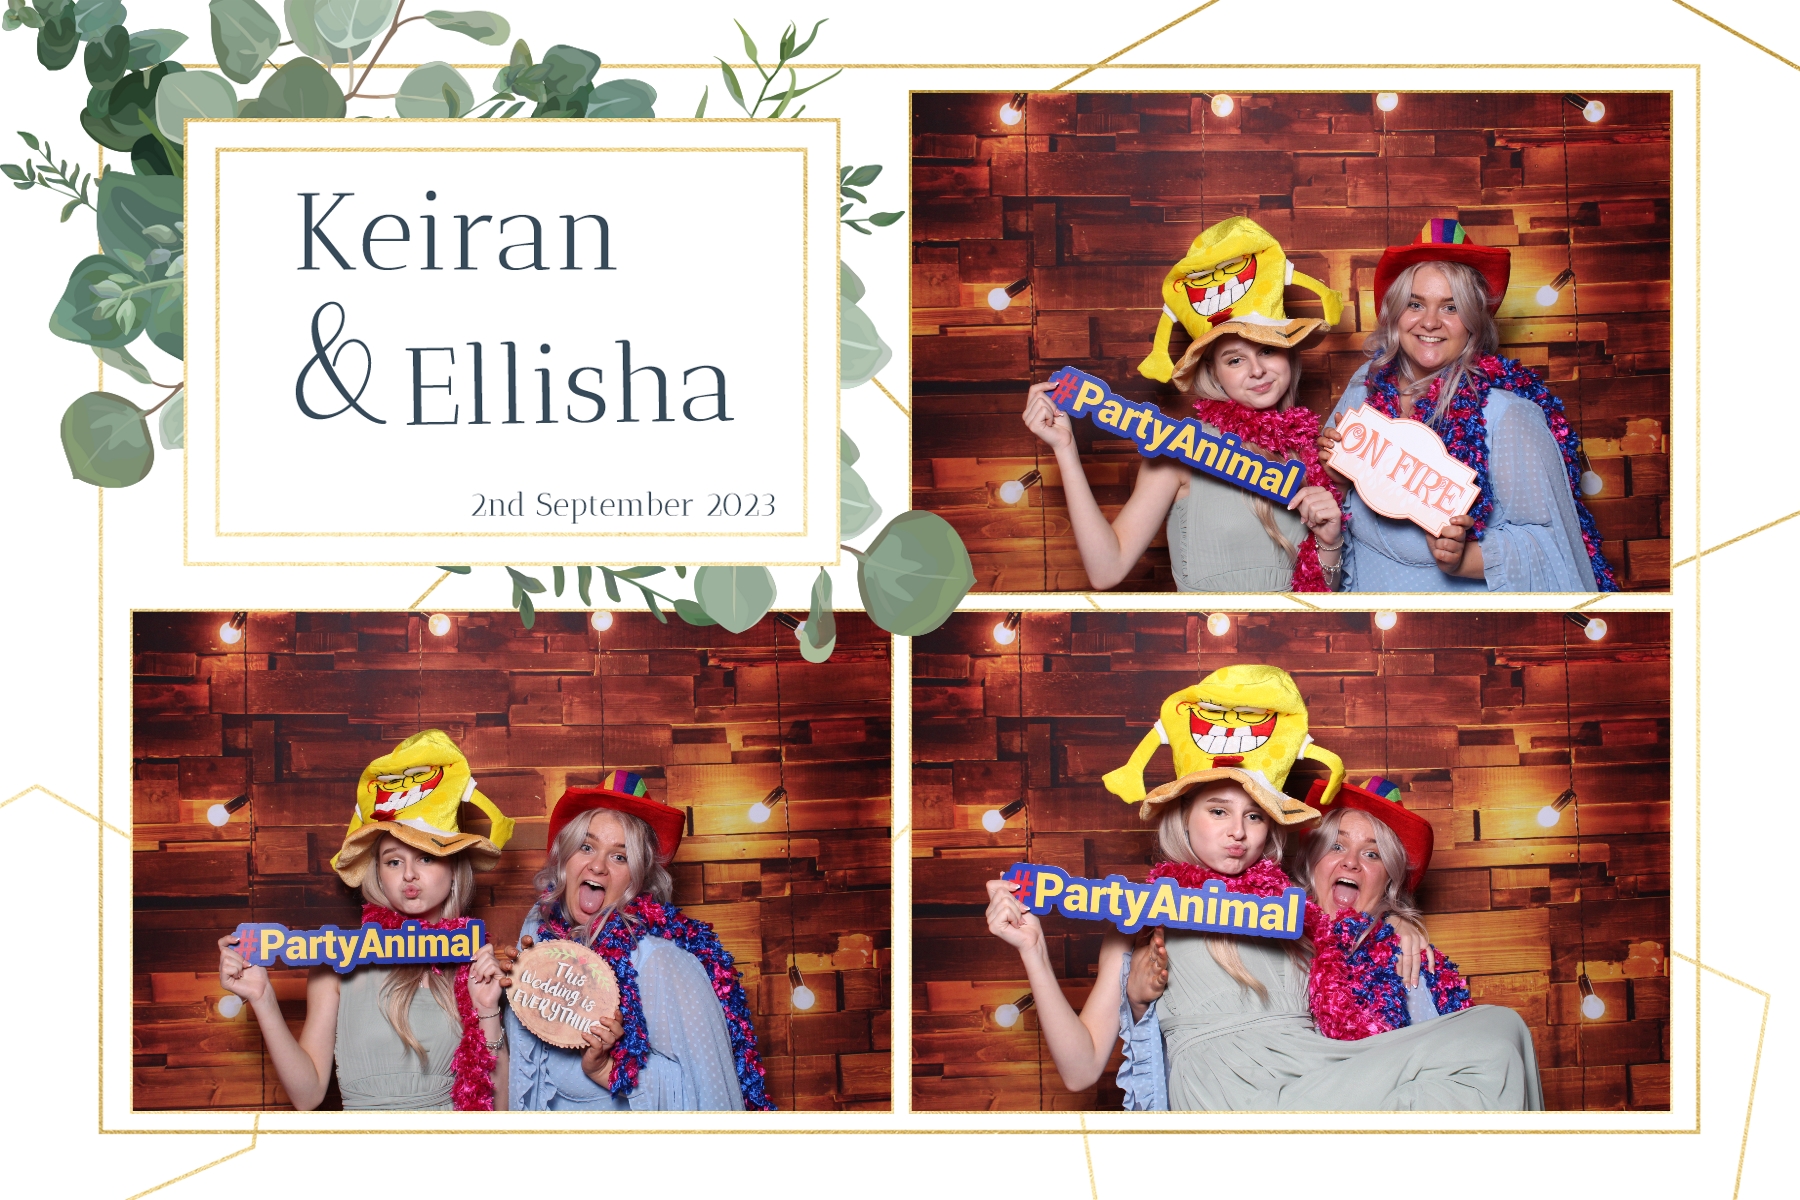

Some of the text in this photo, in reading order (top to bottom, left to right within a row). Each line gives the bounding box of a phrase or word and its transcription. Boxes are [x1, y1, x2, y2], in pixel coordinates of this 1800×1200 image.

[1051, 372, 1300, 499] #PartyAnimal
[1341, 422, 1466, 516] ON FIRE
[1009, 869, 1300, 933] #PartyAnimal
[233, 924, 480, 968] #PartyAnimal
[521, 969, 597, 1012] Wedding is
[556, 961, 588, 987] This
